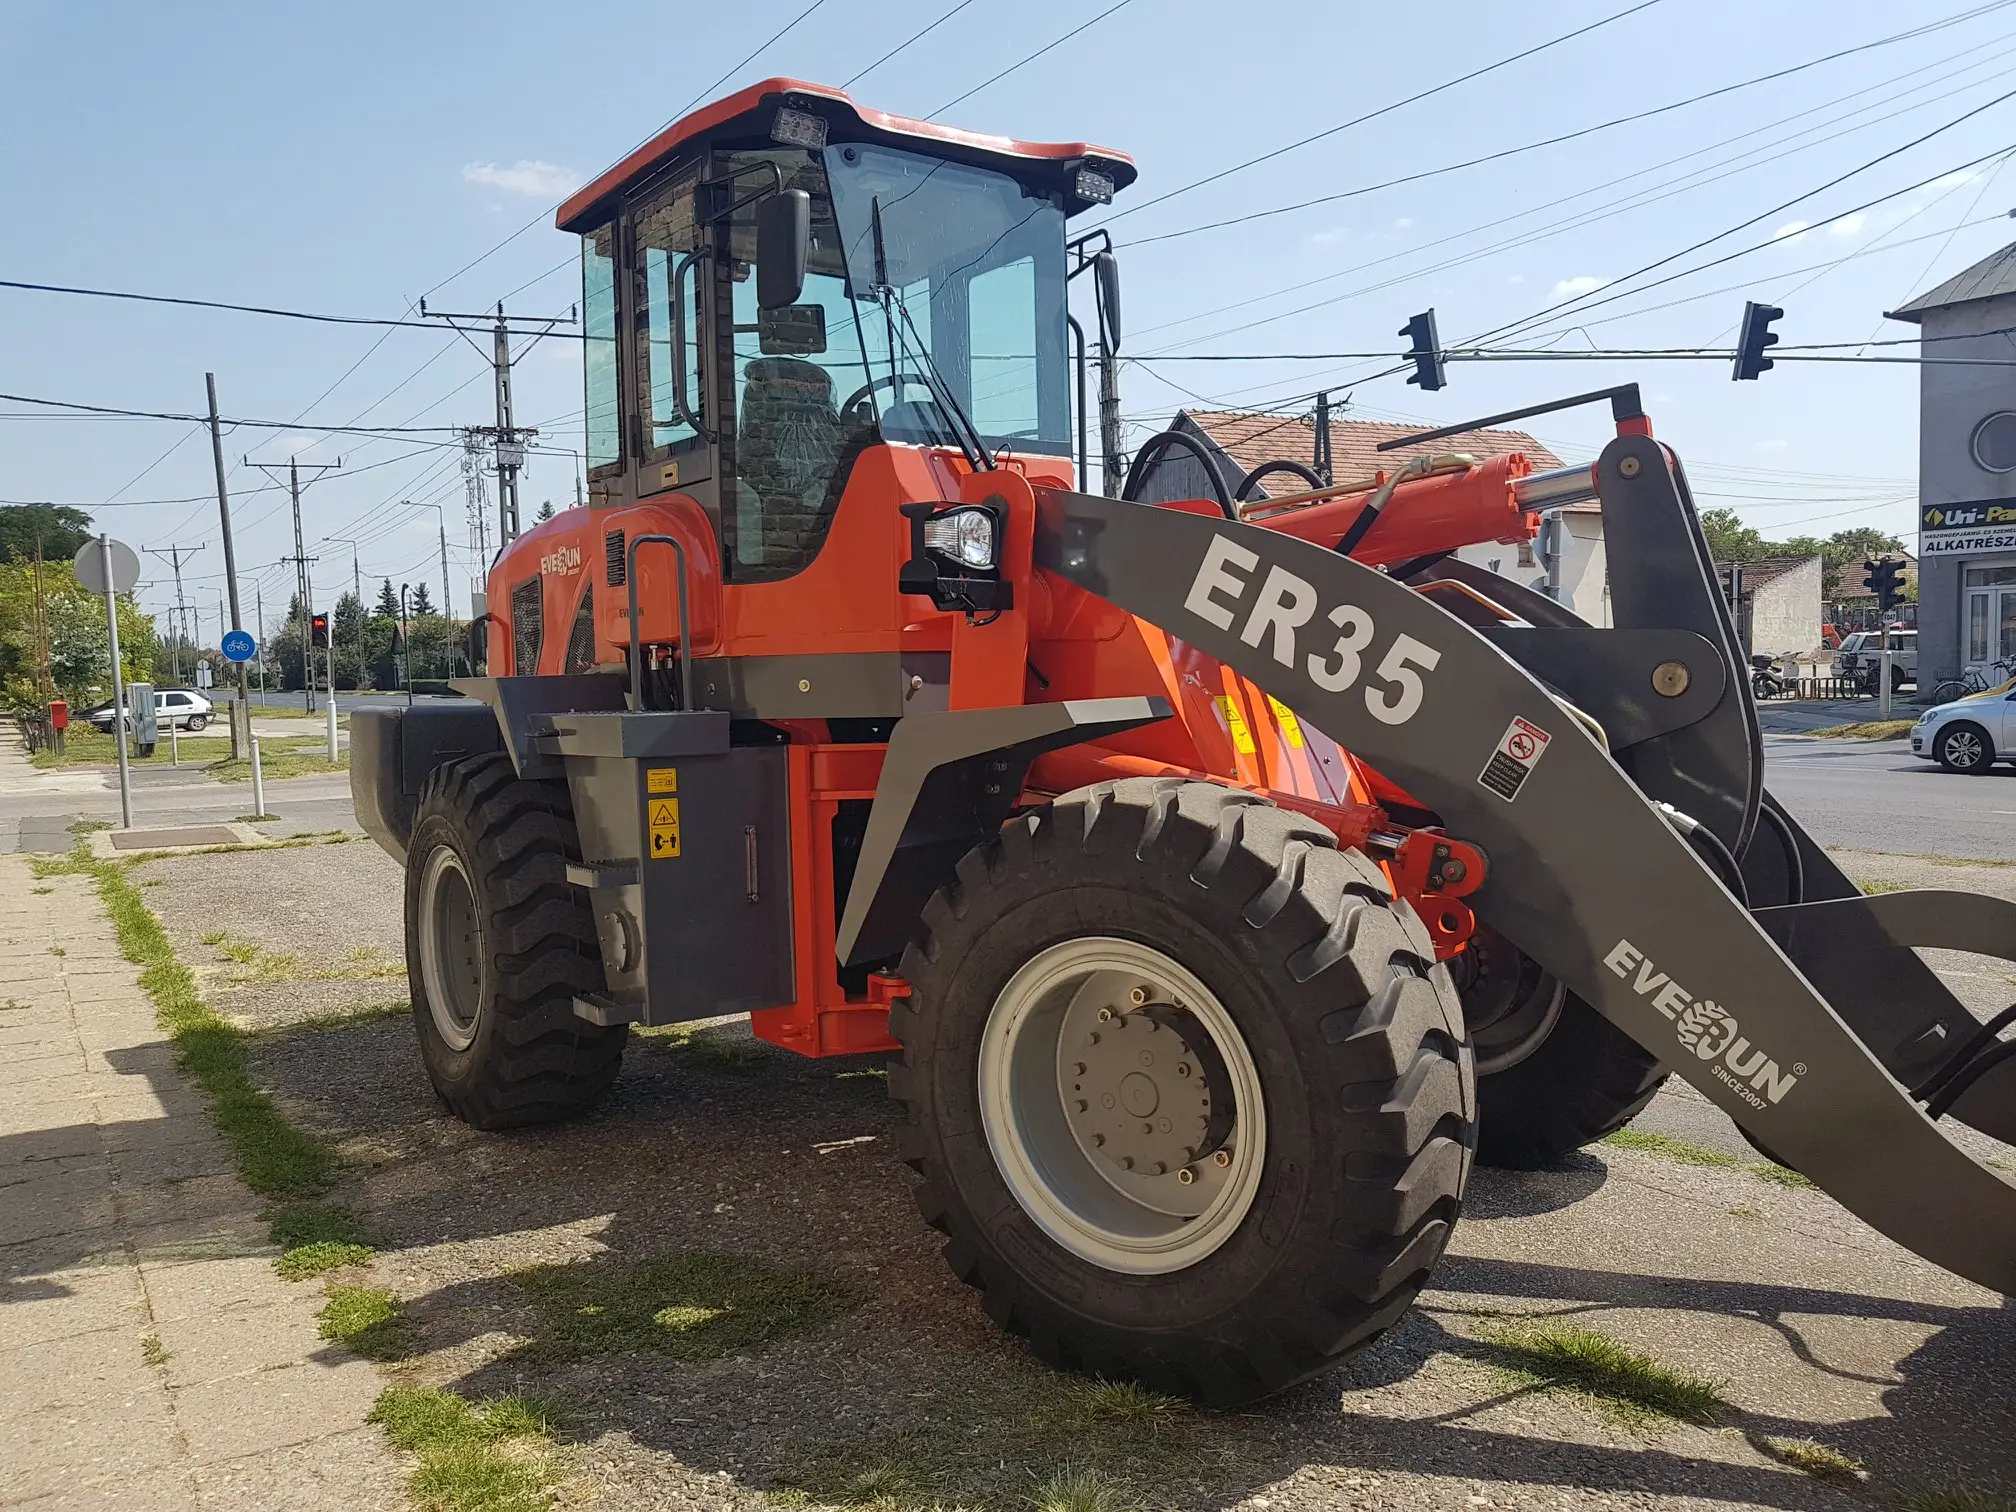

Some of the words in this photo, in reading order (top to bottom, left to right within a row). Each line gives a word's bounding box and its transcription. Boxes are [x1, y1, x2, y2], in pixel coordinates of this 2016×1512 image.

[1183, 533, 1442, 725] ER35
[1525, 725, 1546, 741] DANGER
[1496, 754, 1513, 768] CRUSH
[1512, 763, 1526, 775] RISK
[1711, 1065, 1767, 1111] SINCE2007
